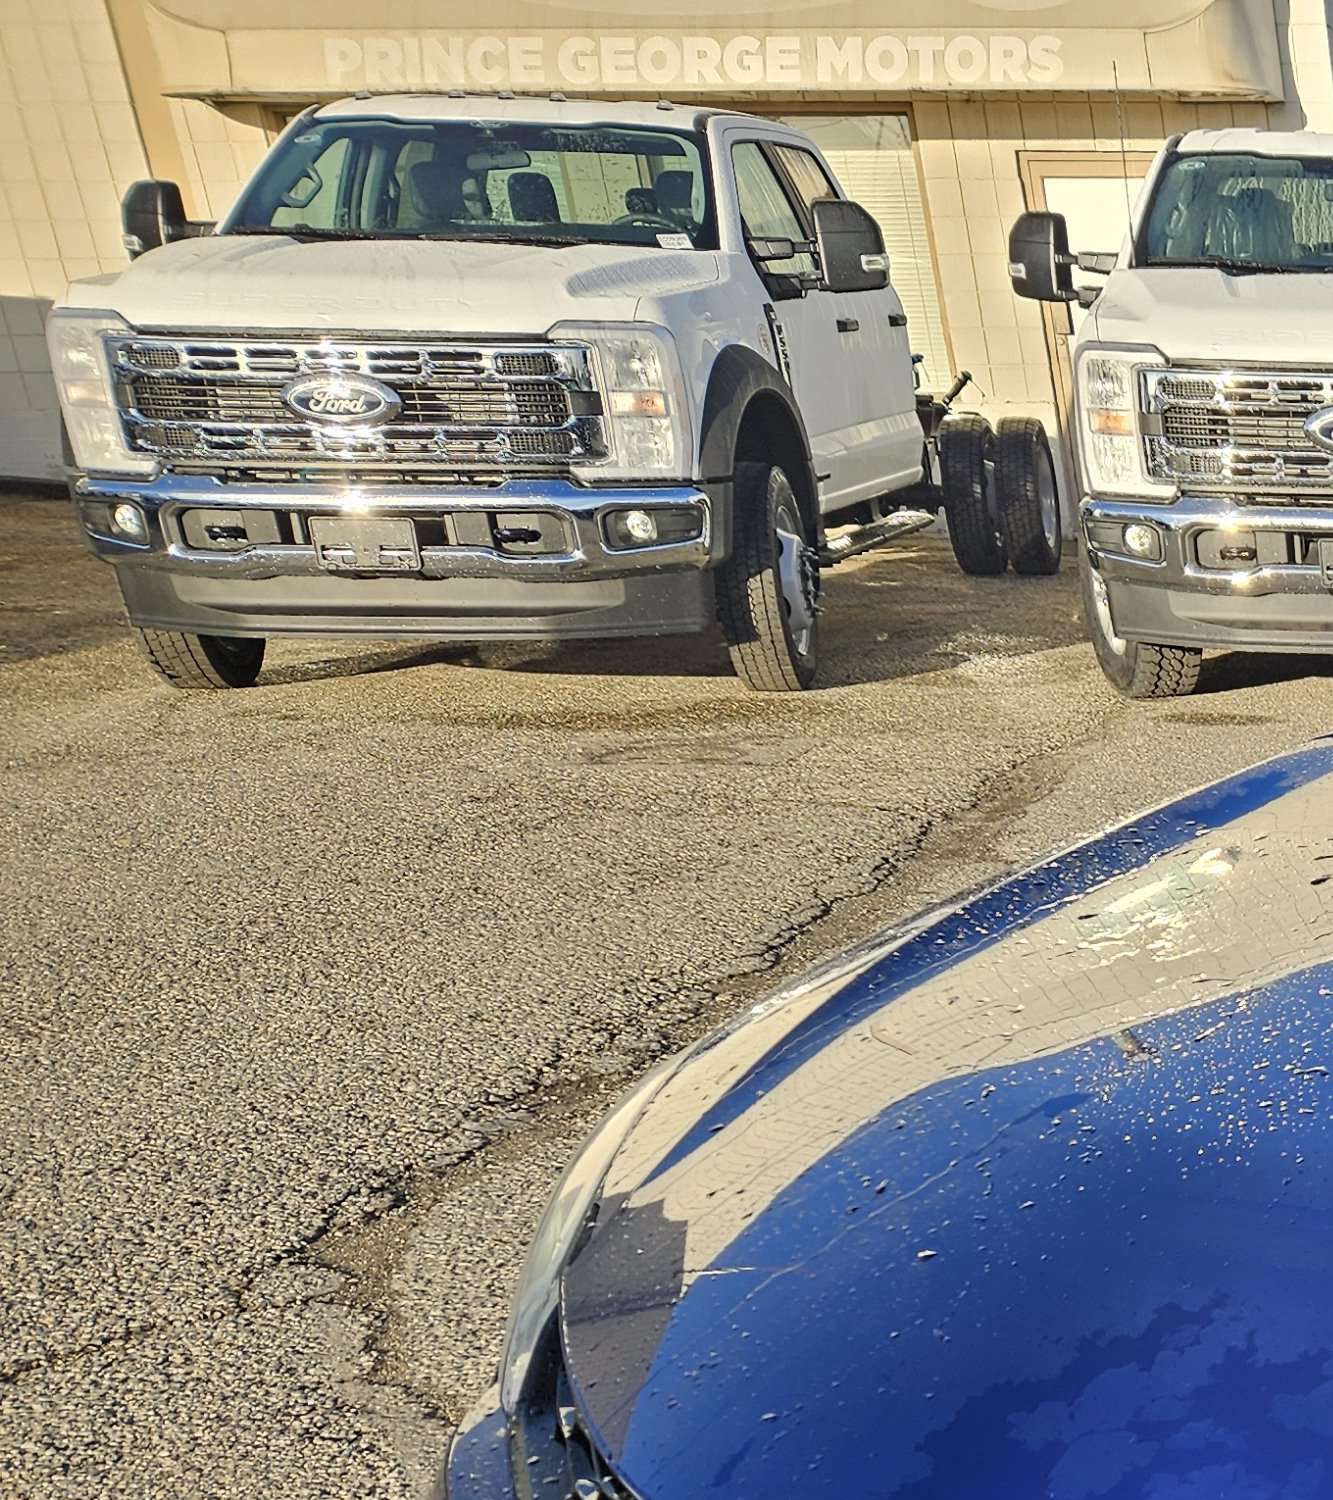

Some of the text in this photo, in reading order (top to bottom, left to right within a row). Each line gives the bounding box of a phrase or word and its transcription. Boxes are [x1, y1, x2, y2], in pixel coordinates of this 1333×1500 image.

[323, 35, 1064, 85] PRINCE GEORGE MOTORS
[307, 389, 368, 415] Ford
